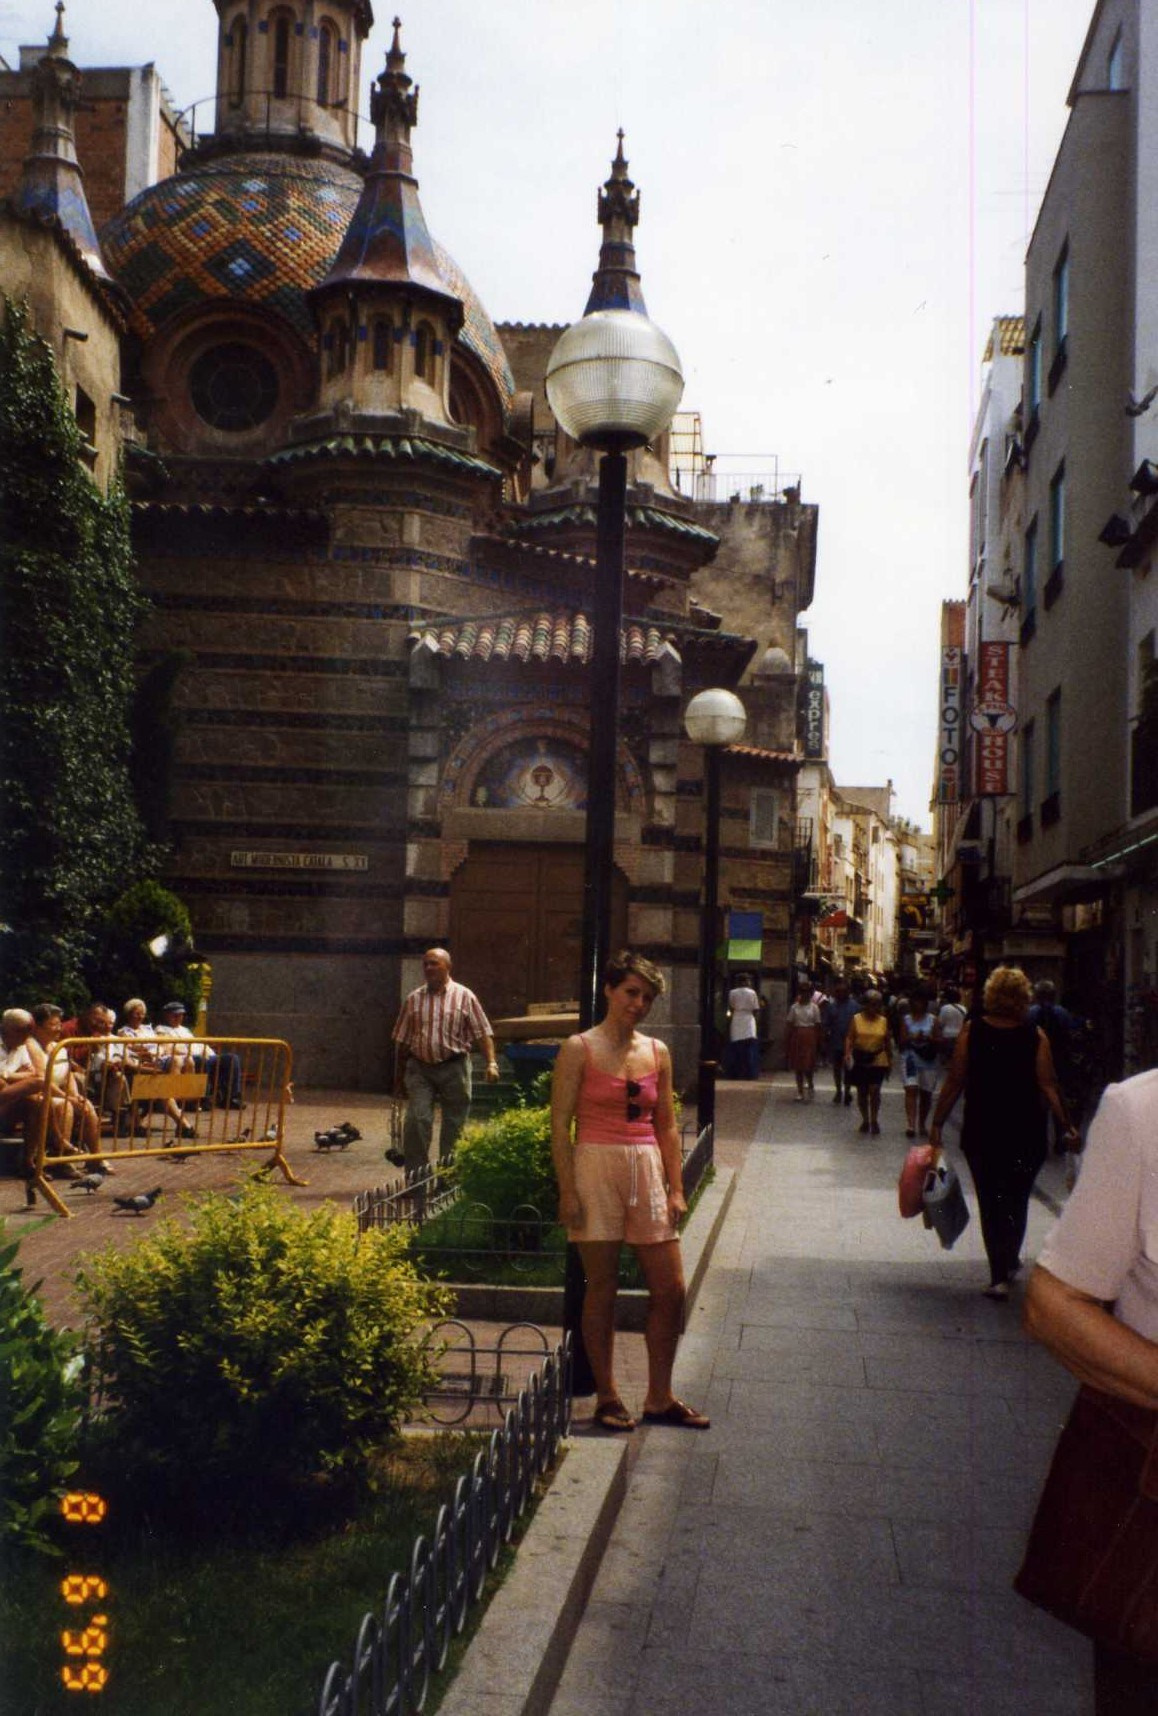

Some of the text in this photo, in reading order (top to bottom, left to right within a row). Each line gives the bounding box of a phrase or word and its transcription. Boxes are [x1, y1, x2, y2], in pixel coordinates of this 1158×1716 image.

[985, 645, 1004, 701] STEAK
[942, 686, 959, 766] FOTO
[982, 735, 1005, 792] HOUSE
